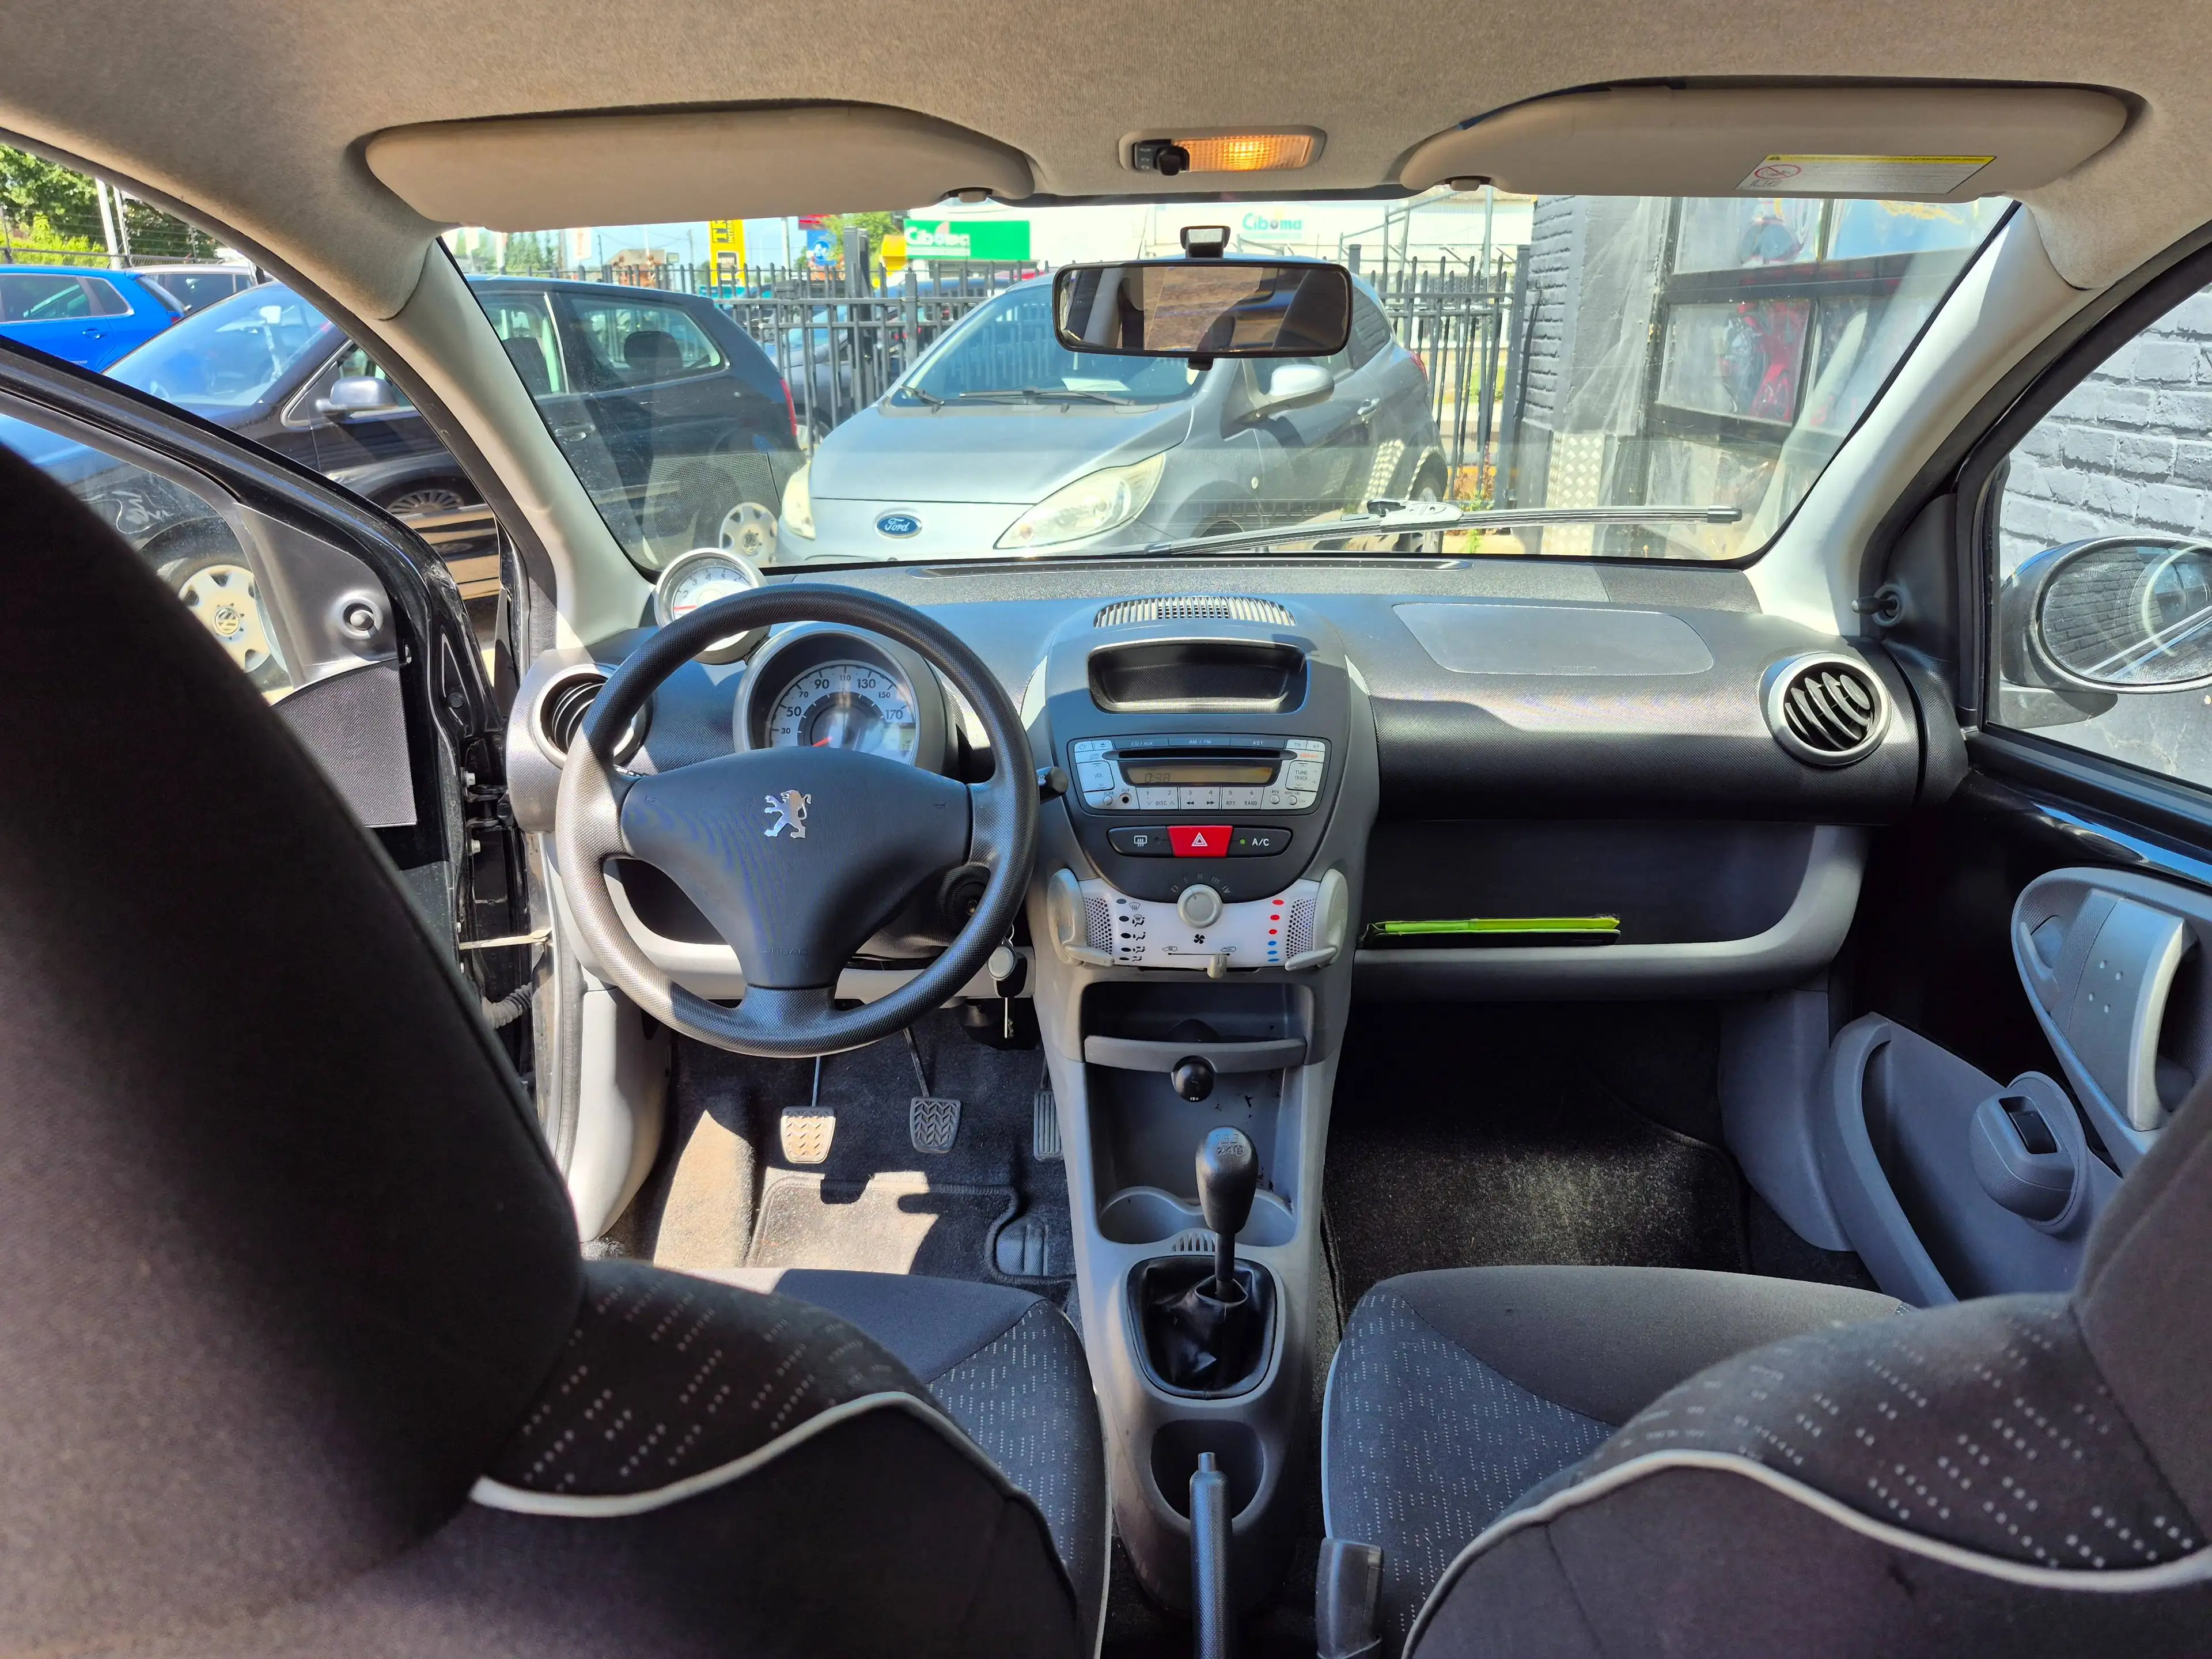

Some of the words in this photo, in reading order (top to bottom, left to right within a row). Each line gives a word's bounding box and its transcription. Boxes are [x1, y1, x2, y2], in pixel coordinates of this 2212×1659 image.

[1243, 212, 1302, 230] Ciboma
[884, 518, 911, 532] Ford
[814, 679, 830, 690] 90
[857, 678, 876, 690] 130
[786, 706, 802, 717] 50
[885, 709, 903, 720] 170
[1252, 838, 1270, 846] A/C
